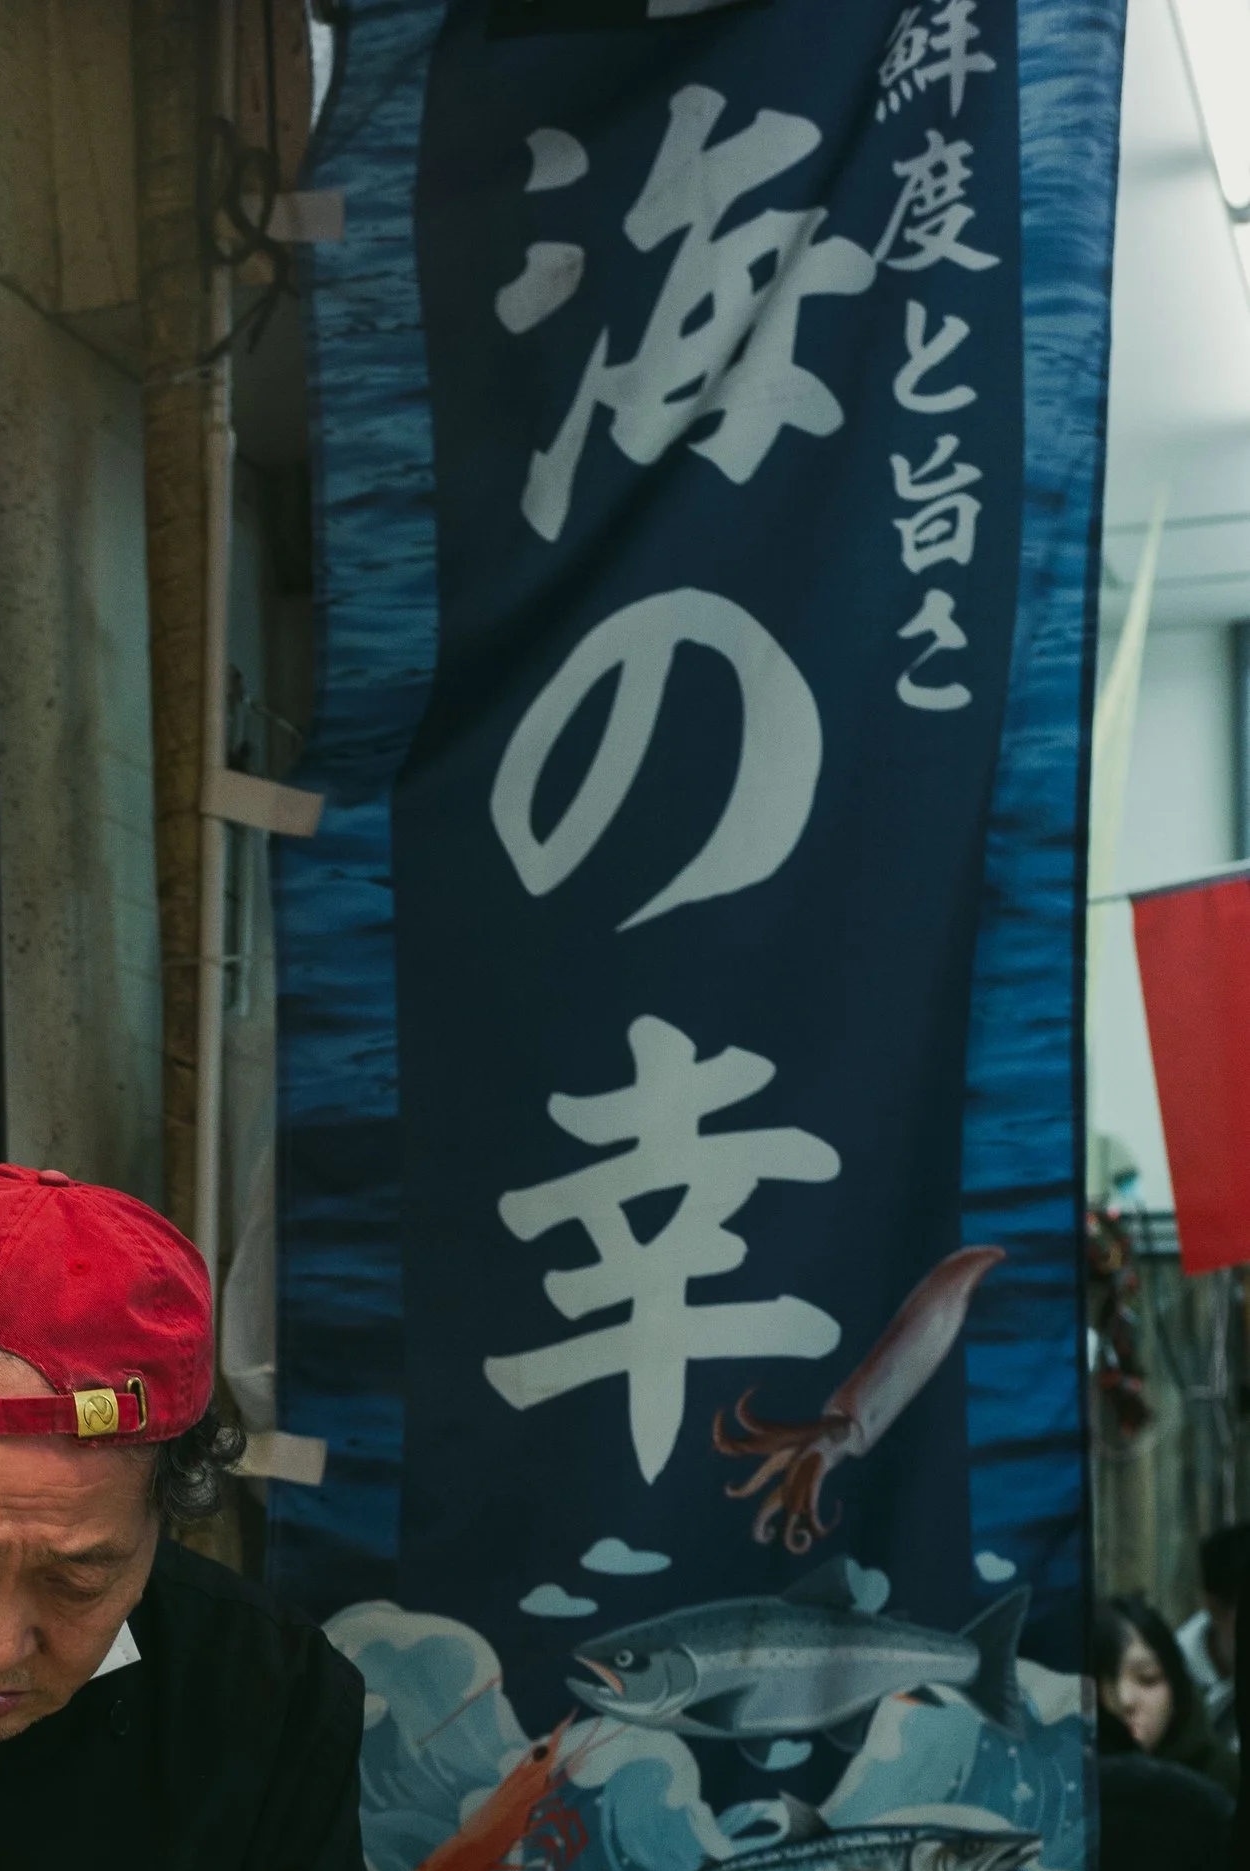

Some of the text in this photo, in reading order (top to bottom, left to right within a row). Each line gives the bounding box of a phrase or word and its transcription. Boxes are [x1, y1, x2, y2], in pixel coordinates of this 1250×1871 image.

[483, 84, 877, 1485] 海の幸
[875, 0, 1001, 711] 鮮度と旨さ
